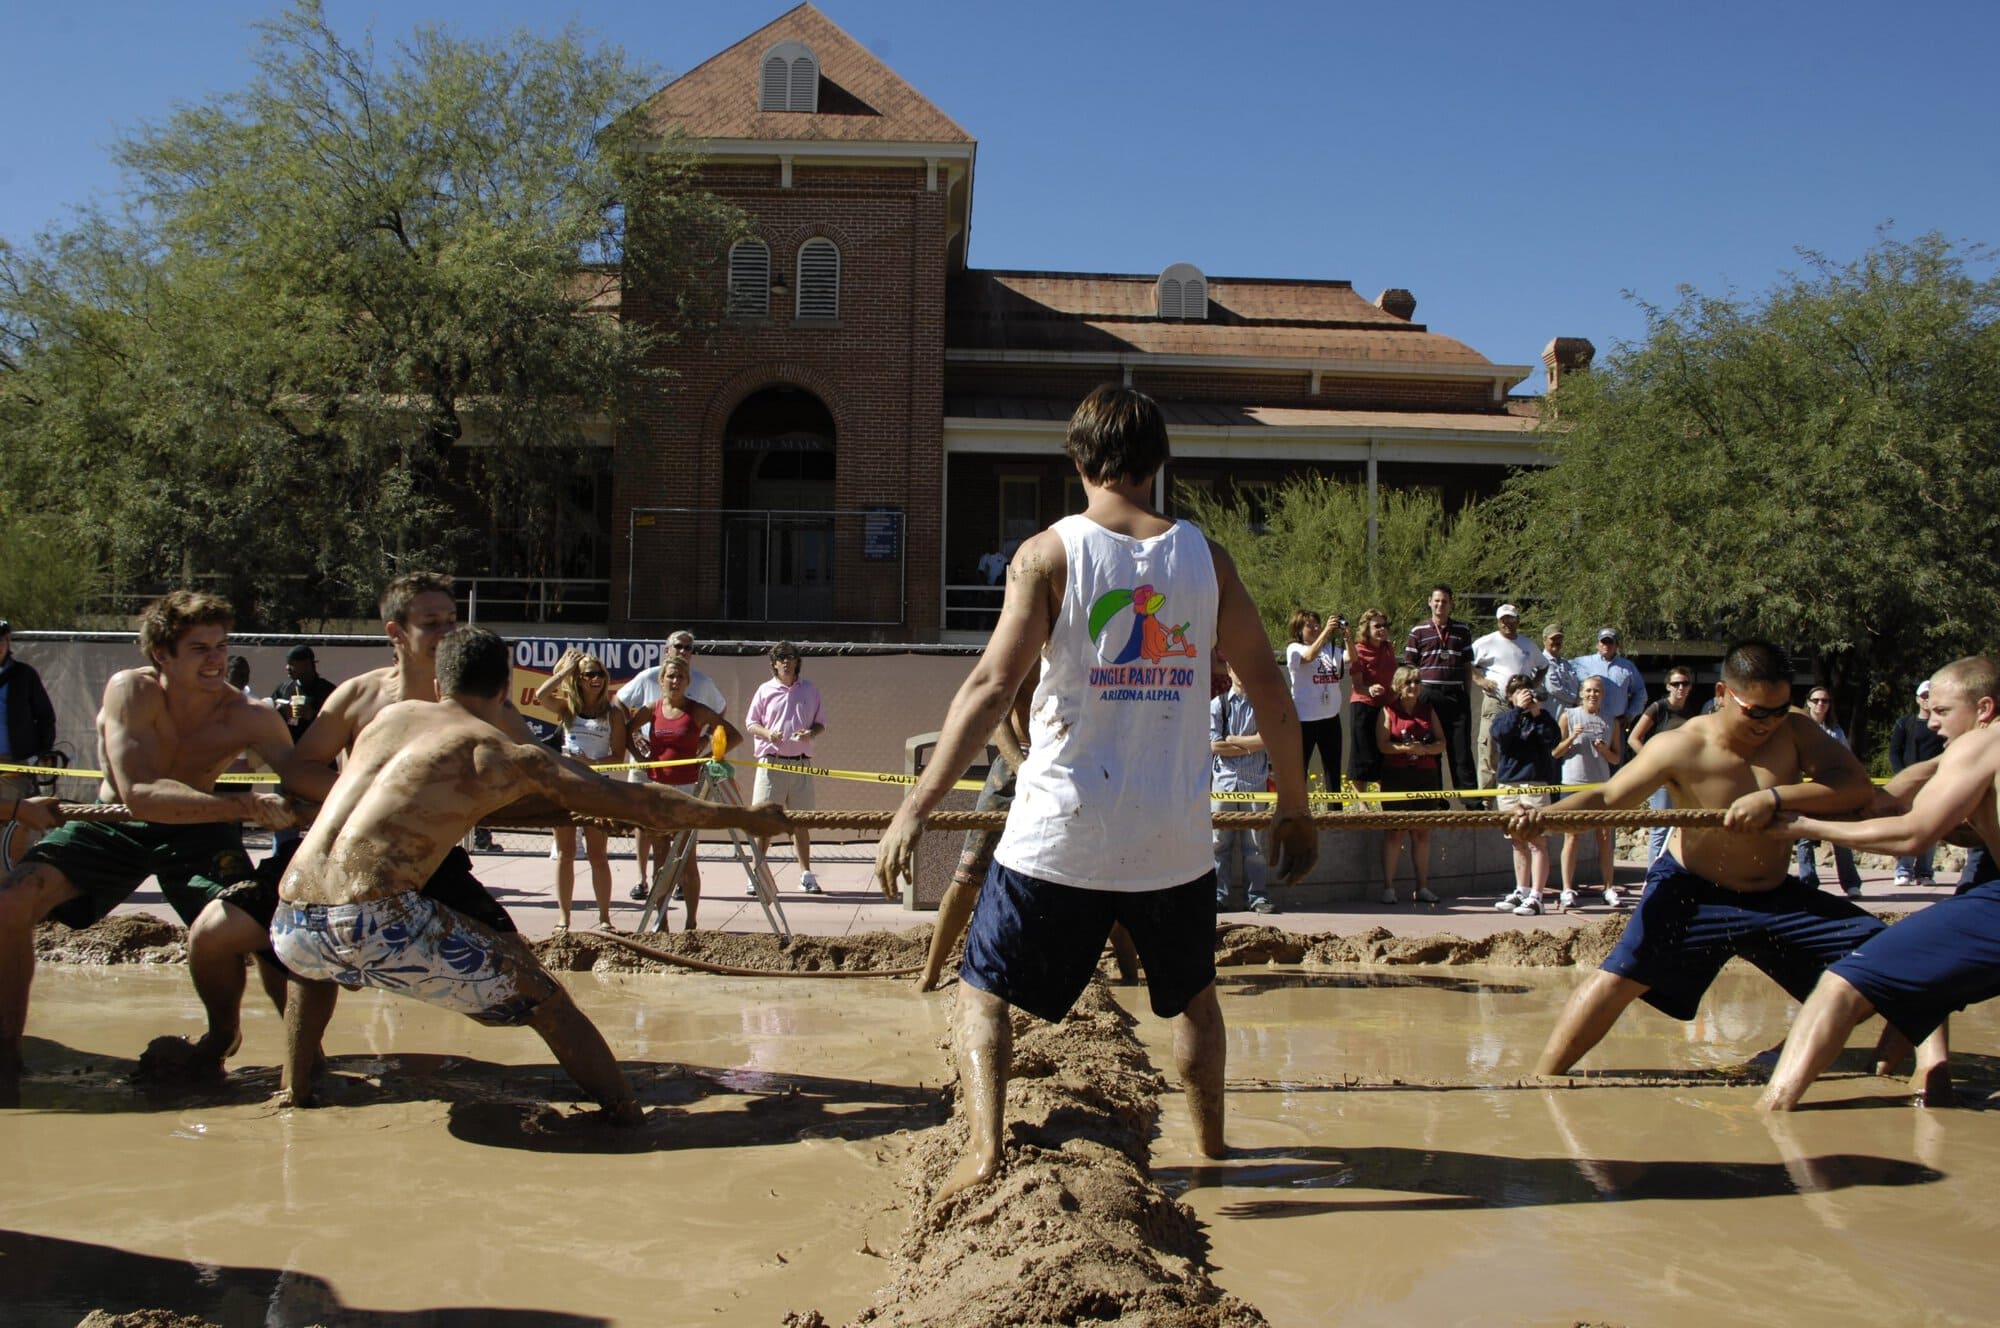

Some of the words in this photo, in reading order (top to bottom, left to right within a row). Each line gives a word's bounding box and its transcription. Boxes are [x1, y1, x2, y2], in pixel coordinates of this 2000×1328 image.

[515, 640, 559, 667] OLD
[1128, 666, 1167, 686] PARTY
[1100, 689, 1143, 701] ARIZONA
[1145, 690, 1180, 701] ALPHA
[878, 774, 917, 784] CAUTI
[1406, 791, 1462, 799] CAUTION
